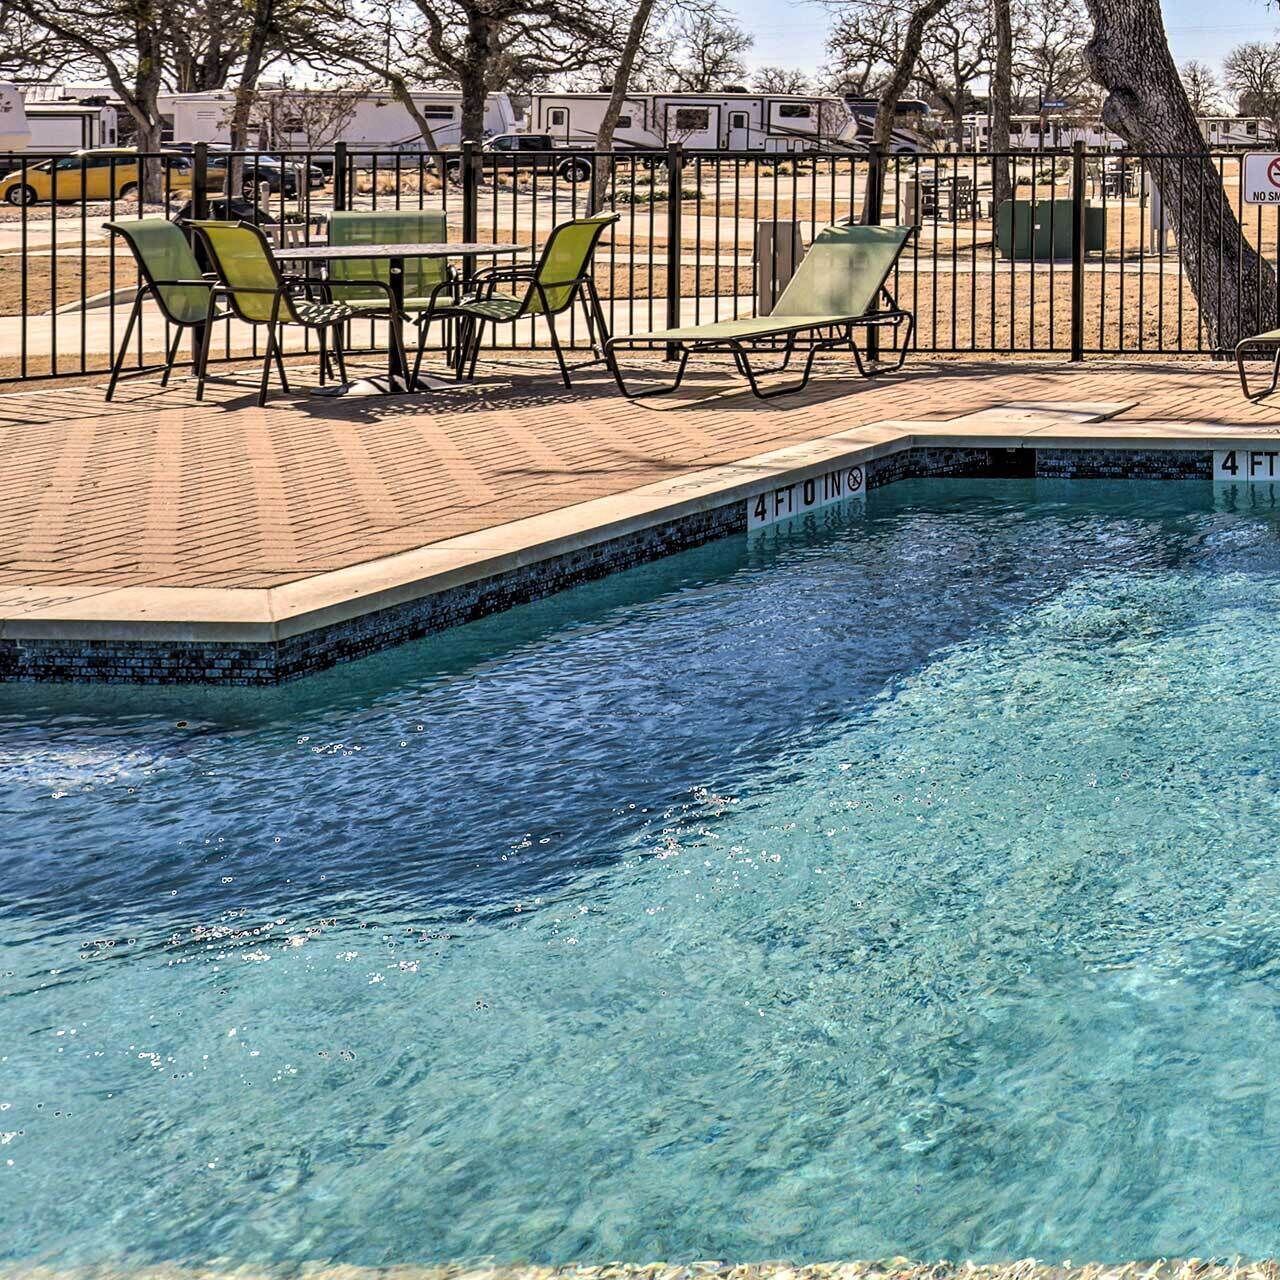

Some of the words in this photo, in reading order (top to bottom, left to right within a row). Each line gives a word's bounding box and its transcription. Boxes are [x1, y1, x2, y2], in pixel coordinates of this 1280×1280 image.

[1253, 191, 1266, 201] NO
[1221, 451, 1238, 476] 4
[1251, 452, 1279, 476] FT
[754, 494, 767, 521] 4
[775, 484, 796, 516] FT
[803, 478, 816, 505] 0
[825, 470, 841, 500] IN
